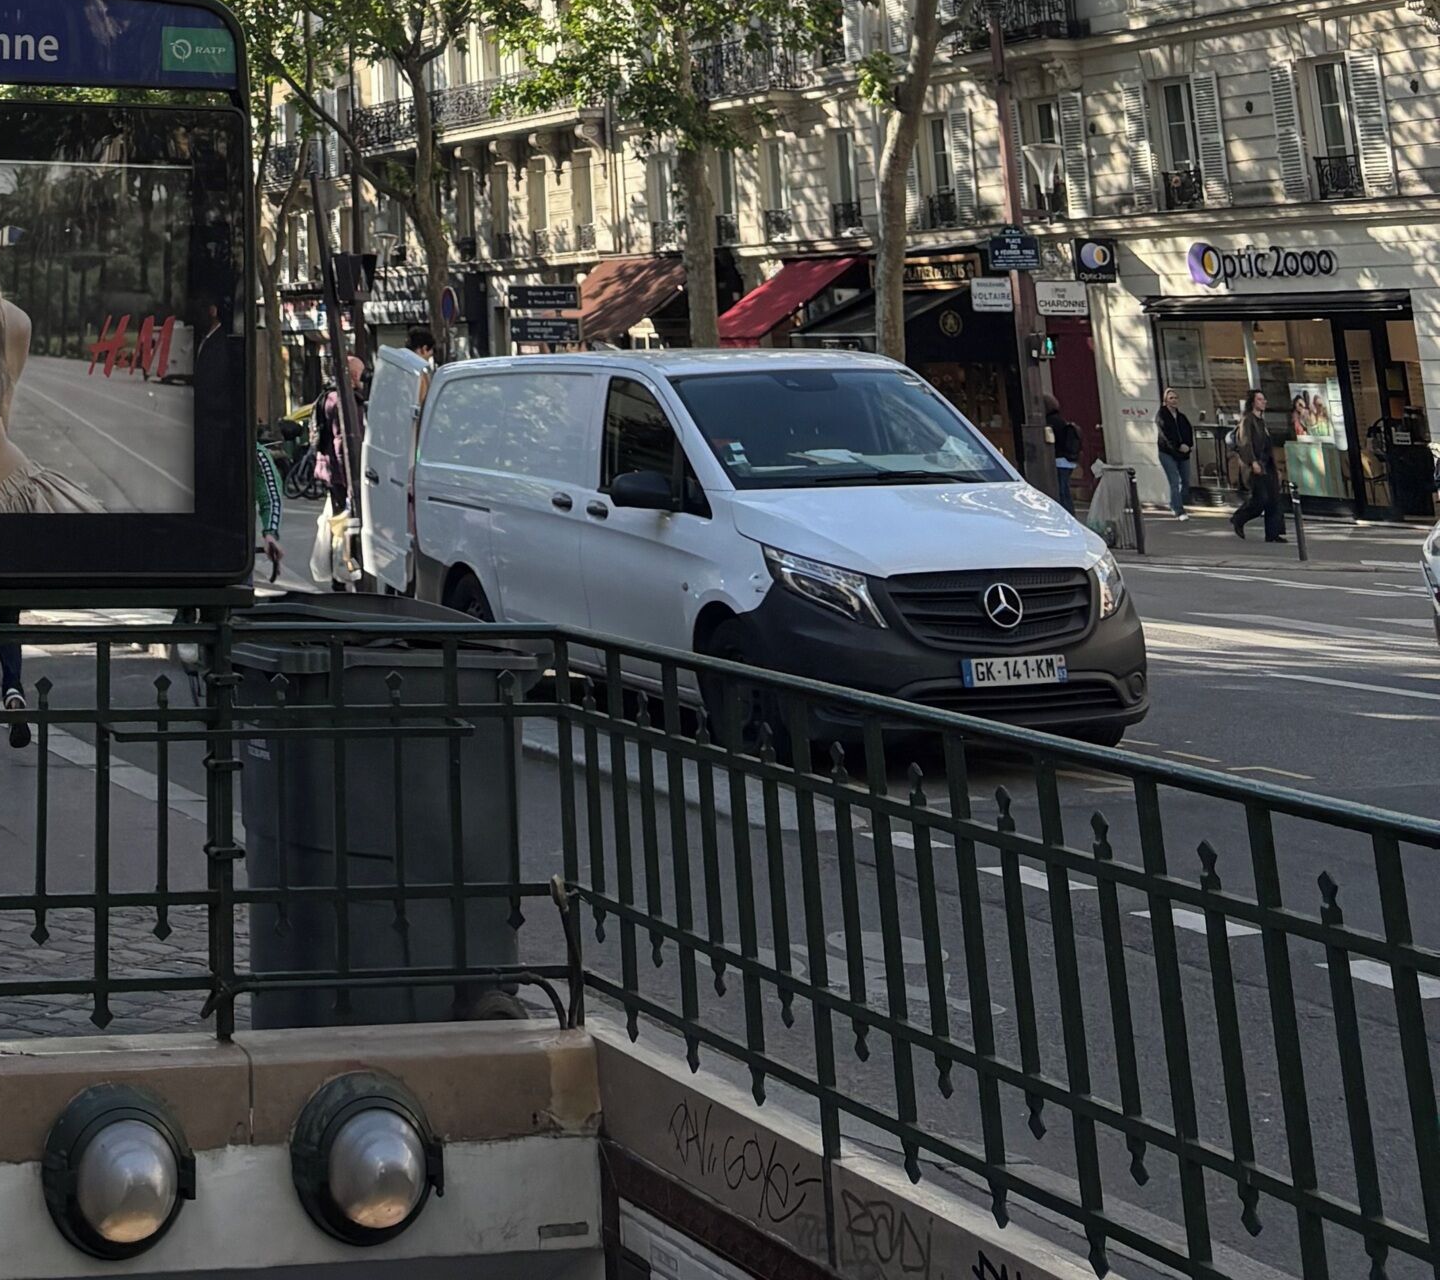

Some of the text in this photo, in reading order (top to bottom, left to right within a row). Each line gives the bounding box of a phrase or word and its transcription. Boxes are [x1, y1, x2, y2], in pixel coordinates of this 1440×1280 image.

[195, 46, 226, 55] RATP
[973, 292, 1012, 301] VOLTAIRE
[1039, 299, 1087, 308] CHARONNE
[88, 314, 176, 378] H&M
